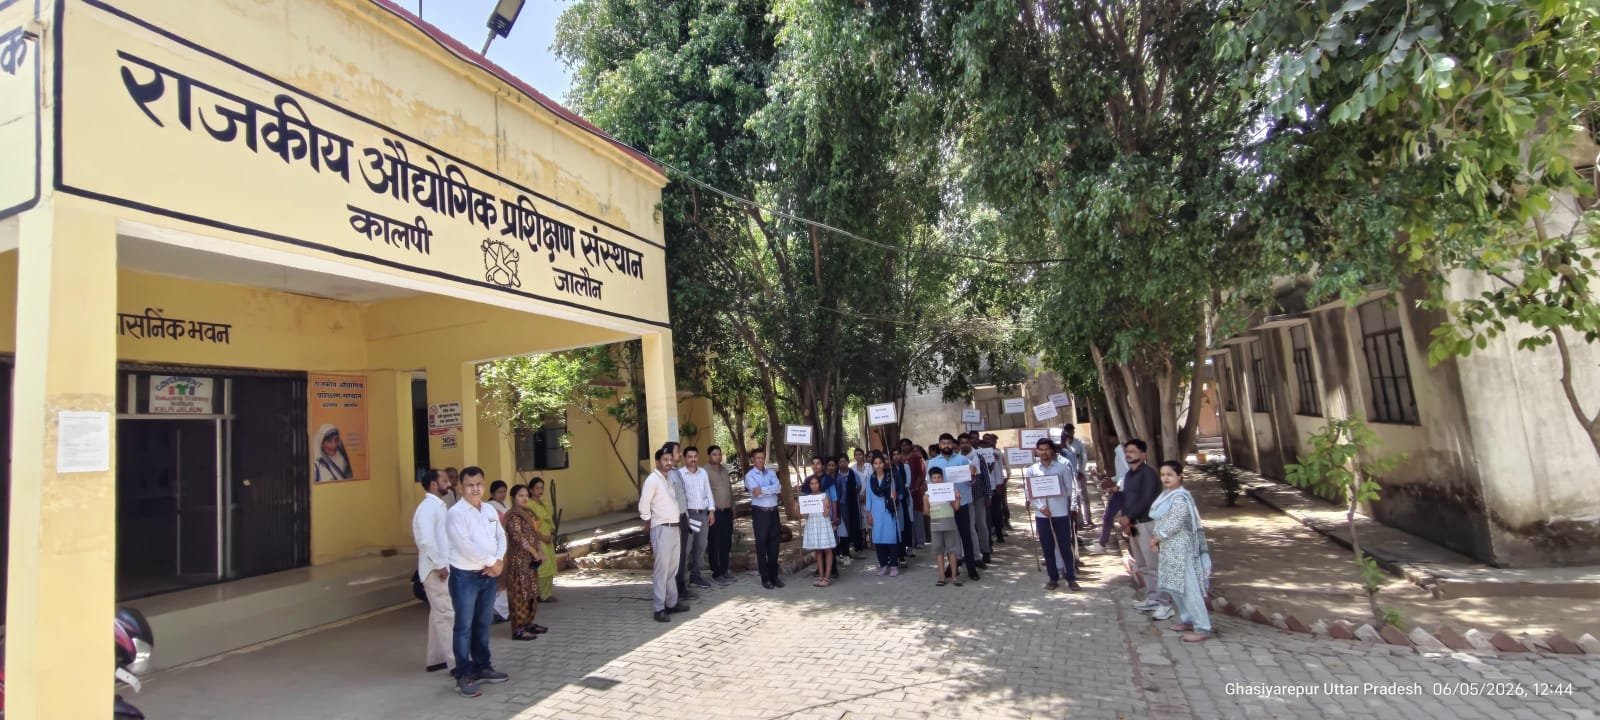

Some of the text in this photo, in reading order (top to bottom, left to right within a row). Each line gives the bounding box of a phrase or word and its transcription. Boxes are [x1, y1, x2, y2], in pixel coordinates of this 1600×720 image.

[116, 49, 644, 280] राजकीय औद्योगिक प्रशिक्षण संस्थान
[347, 204, 433, 255] कालपी
[552, 267, 603, 300] जालौन
[188, 320, 232, 344] भवन
